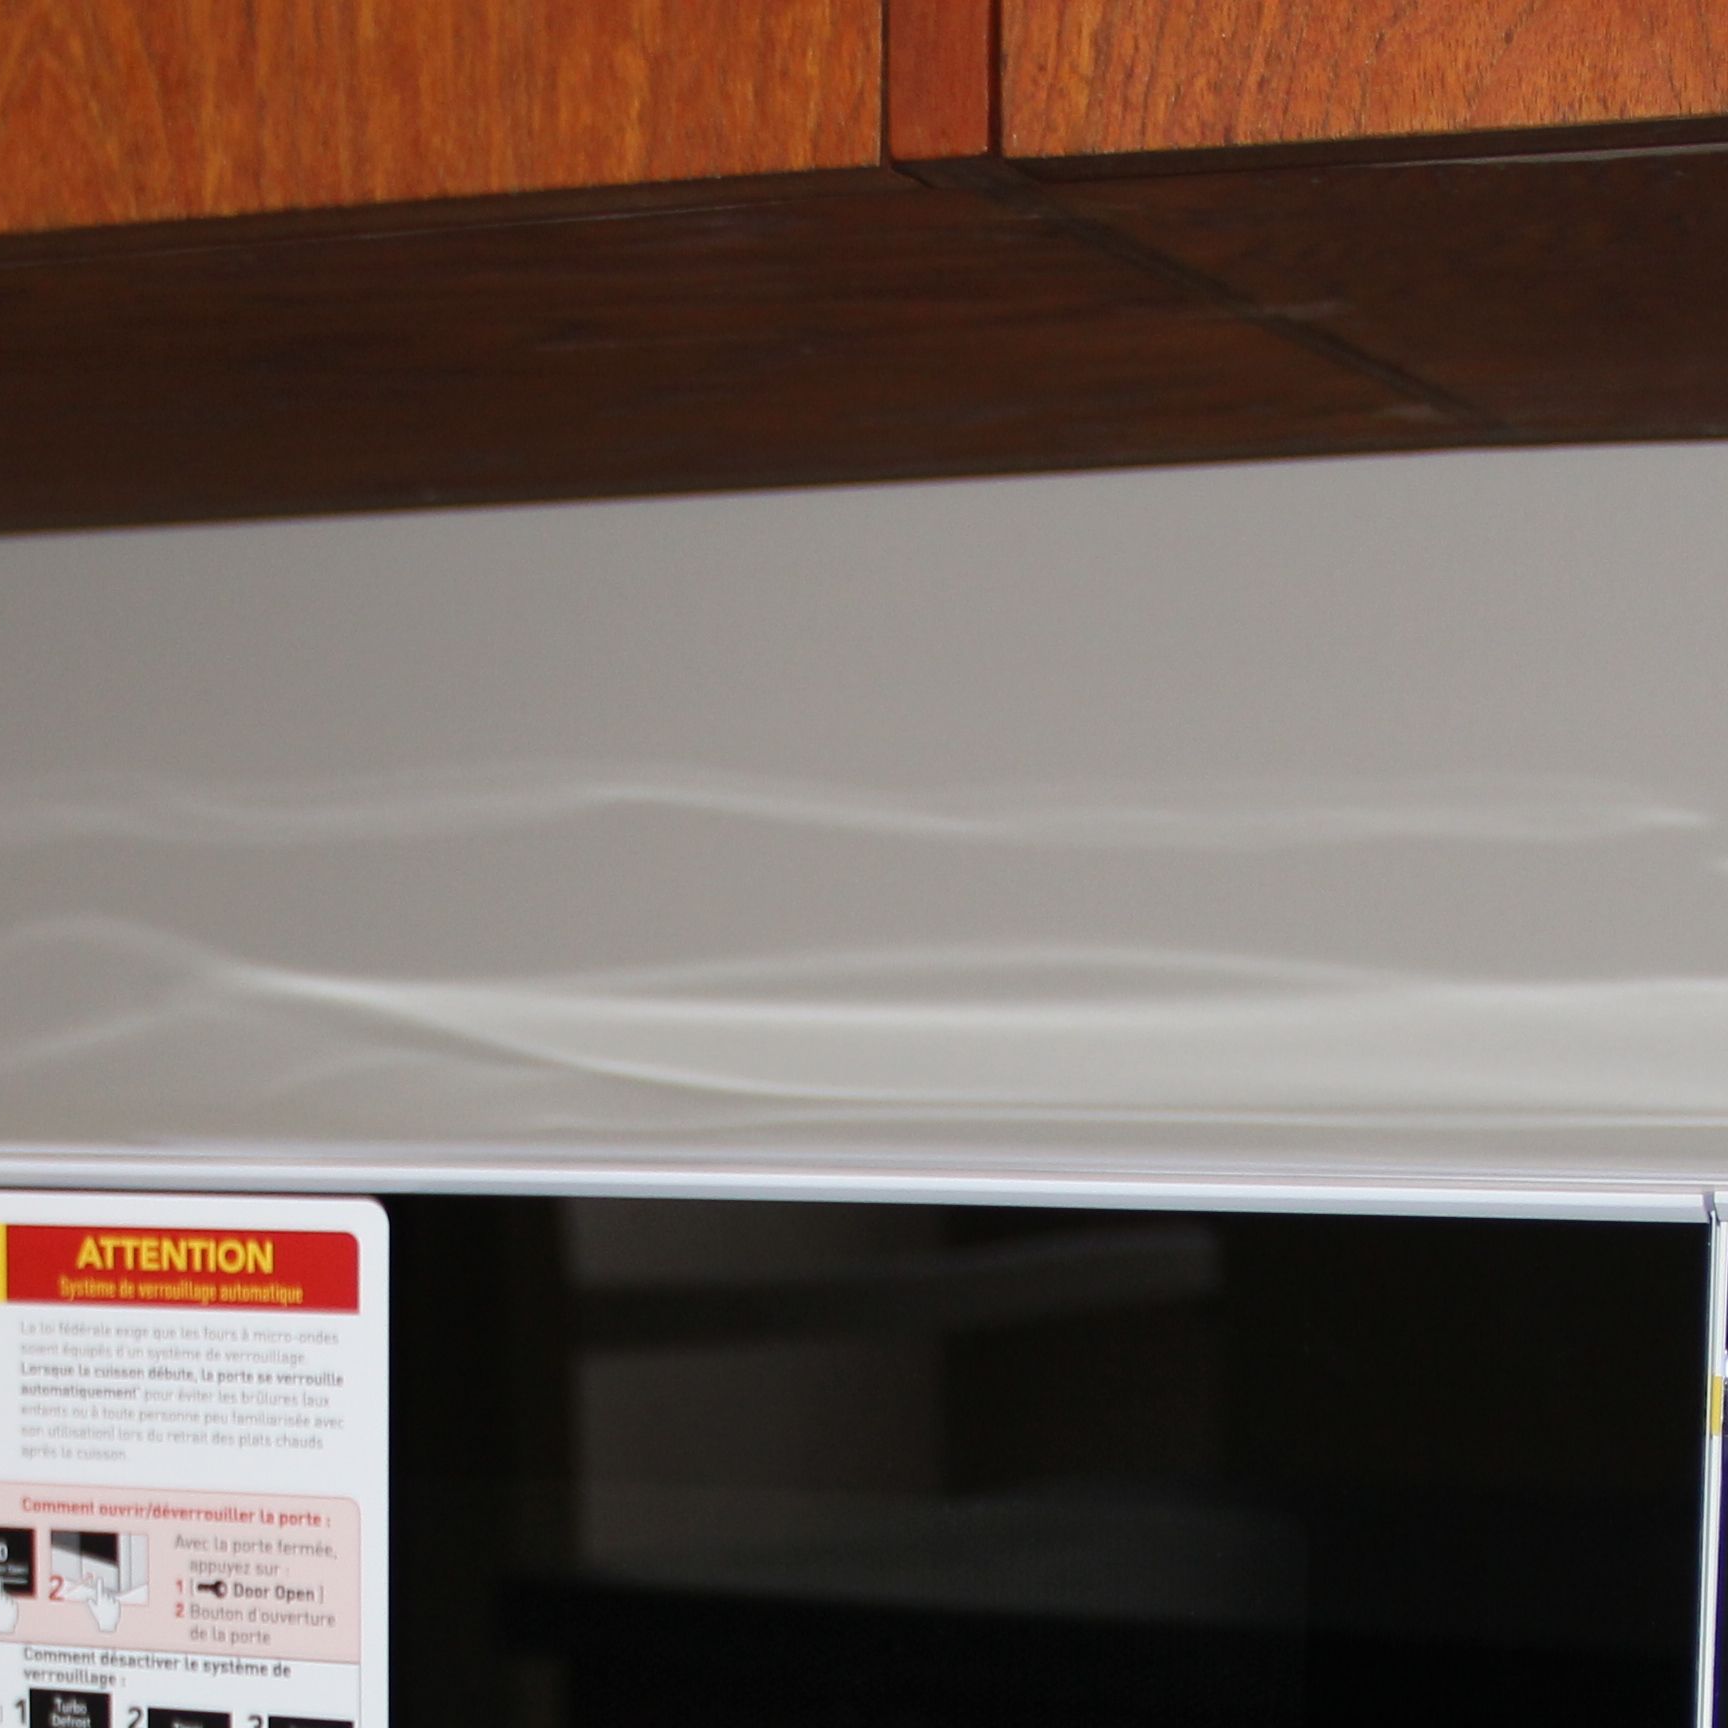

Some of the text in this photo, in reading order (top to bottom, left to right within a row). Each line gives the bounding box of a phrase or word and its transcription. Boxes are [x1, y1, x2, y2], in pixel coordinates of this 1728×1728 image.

[77, 1237, 274, 1274] ATTENTION
[60, 1278, 303, 1307] Système de verrouillage automatique
[20, 1363, 344, 1387] Lorsque la cuisson débute, la porte se verrouille
[22, 1498, 322, 1529] Comment ouvrir/déverrouiller la porte
[174, 1536, 337, 1560] Avec la porte fermée,
[49, 1576, 64, 1600] 2
[233, 1584, 268, 1598] Door
[275, 1586, 315, 1604] Open
[176, 1605, 184, 1618] 2
[190, 1605, 243, 1621] Bouton
[190, 1627, 271, 1647] de la porte
[24, 1648, 291, 1678] Comment désactiver le système de
[24, 1669, 116, 1688] verrouillage
[15, 1700, 27, 1724] 1
